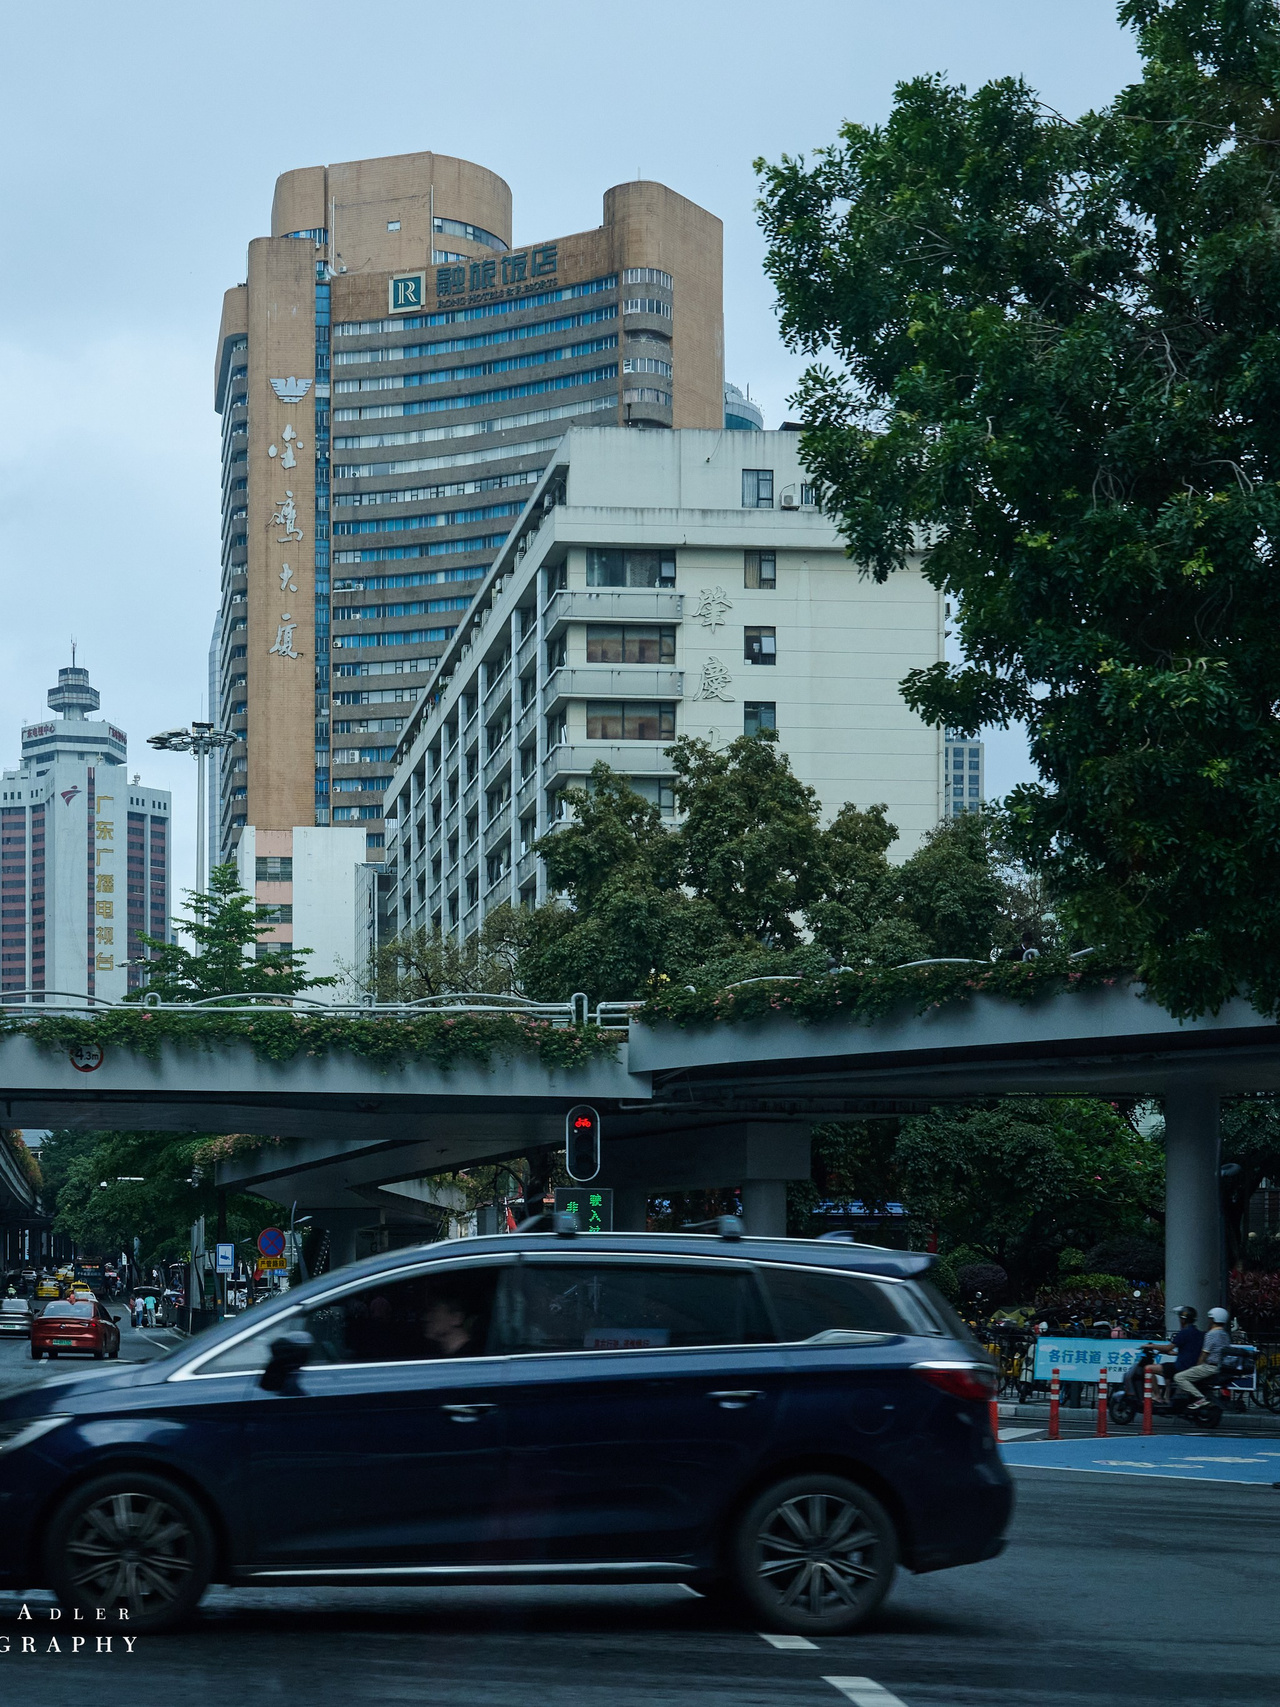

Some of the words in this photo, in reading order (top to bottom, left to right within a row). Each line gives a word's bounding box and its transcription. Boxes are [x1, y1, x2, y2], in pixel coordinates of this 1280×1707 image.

[437, 245, 558, 298] 融旅饭店
[397, 281, 419, 305] R
[468, 290, 504, 304] HOTELS
[96, 796, 114, 971] 广东广播电视台
[1049, 1350, 1101, 1364] 各行其道
